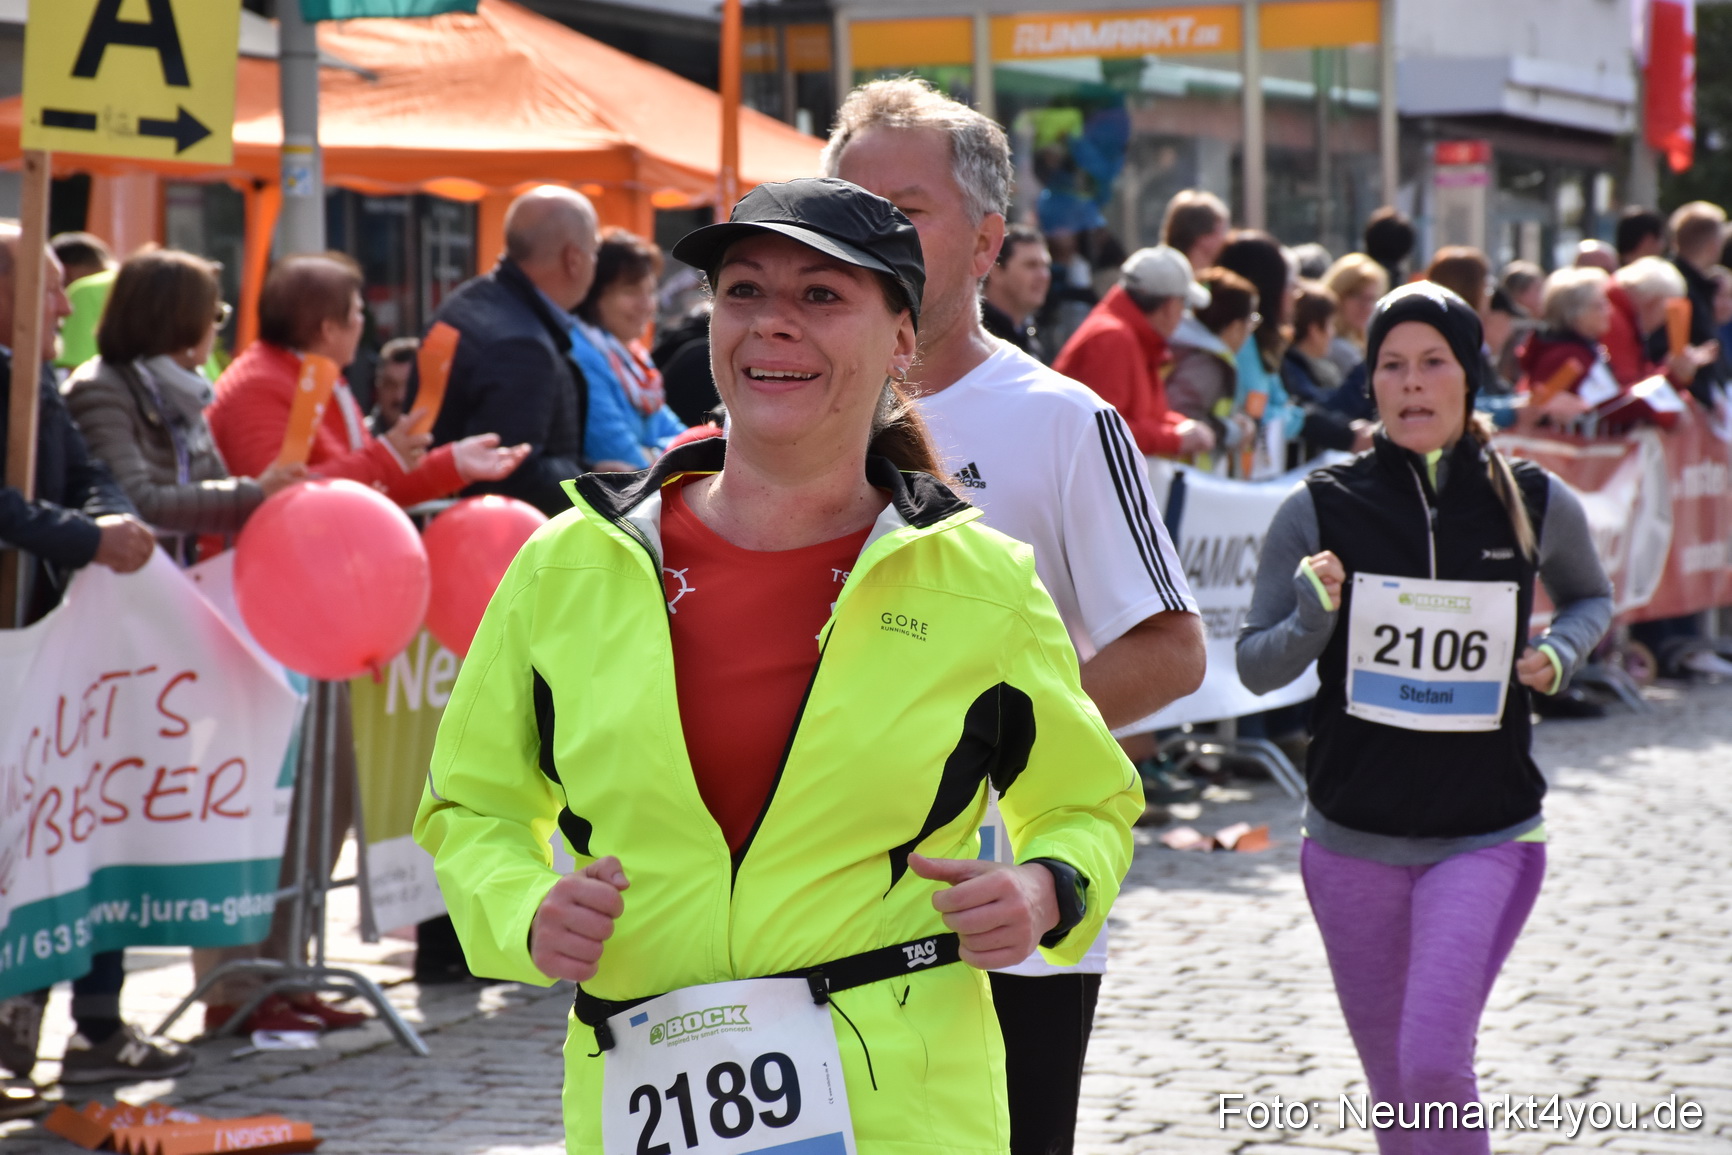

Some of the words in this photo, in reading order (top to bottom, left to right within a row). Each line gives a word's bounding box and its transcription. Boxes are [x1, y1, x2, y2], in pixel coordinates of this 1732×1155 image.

[70, 0, 191, 88] A
[880, 625, 910, 636] RUNNING
[911, 633, 926, 642] WEAR
[881, 612, 928, 635] GORE
[1373, 624, 1488, 672] 2106
[1399, 684, 1454, 705] Stefani
[666, 1005, 750, 1039] BOCK
[667, 1035, 690, 1048] inspired
[691, 1034, 699, 1042] by
[701, 1028, 719, 1039] smart
[720, 1025, 753, 1034] concepts
[628, 1051, 802, 1155] 2189
